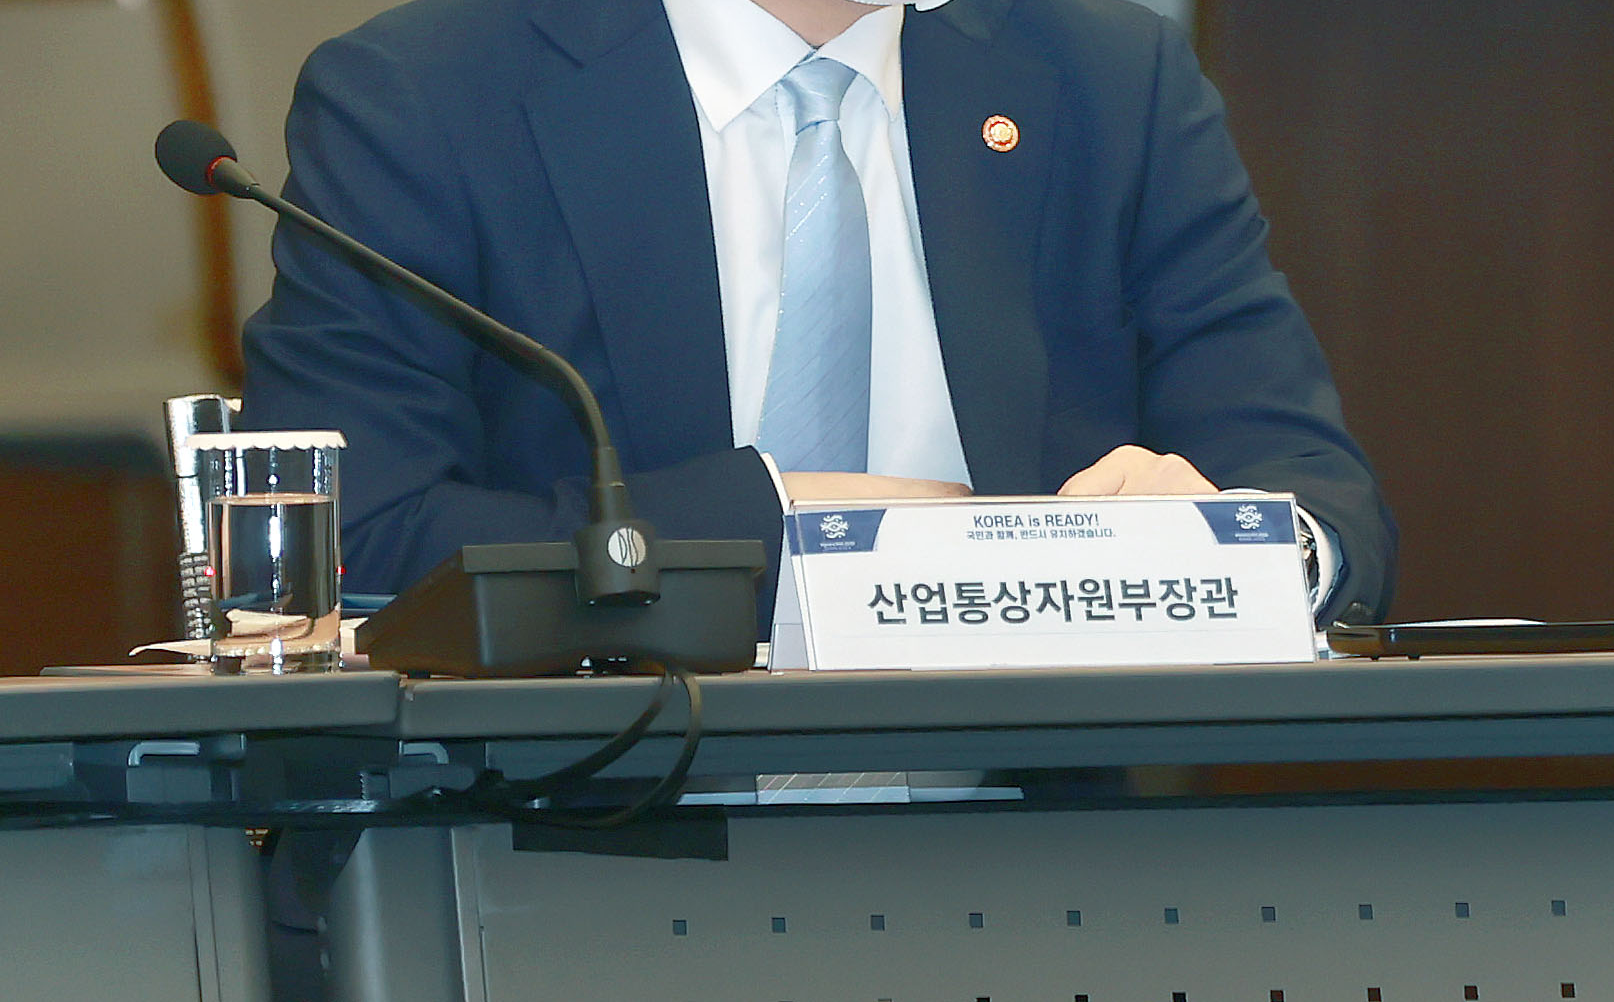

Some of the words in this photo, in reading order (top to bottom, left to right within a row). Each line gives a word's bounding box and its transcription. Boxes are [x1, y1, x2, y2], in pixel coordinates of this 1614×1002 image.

[973, 514, 1024, 529] KOREA
[1028, 514, 1041, 527] is
[1044, 513, 1100, 527] READY!
[1020, 529, 1047, 540] 반드시
[867, 576, 1239, 626] 산업통상자원부장관
